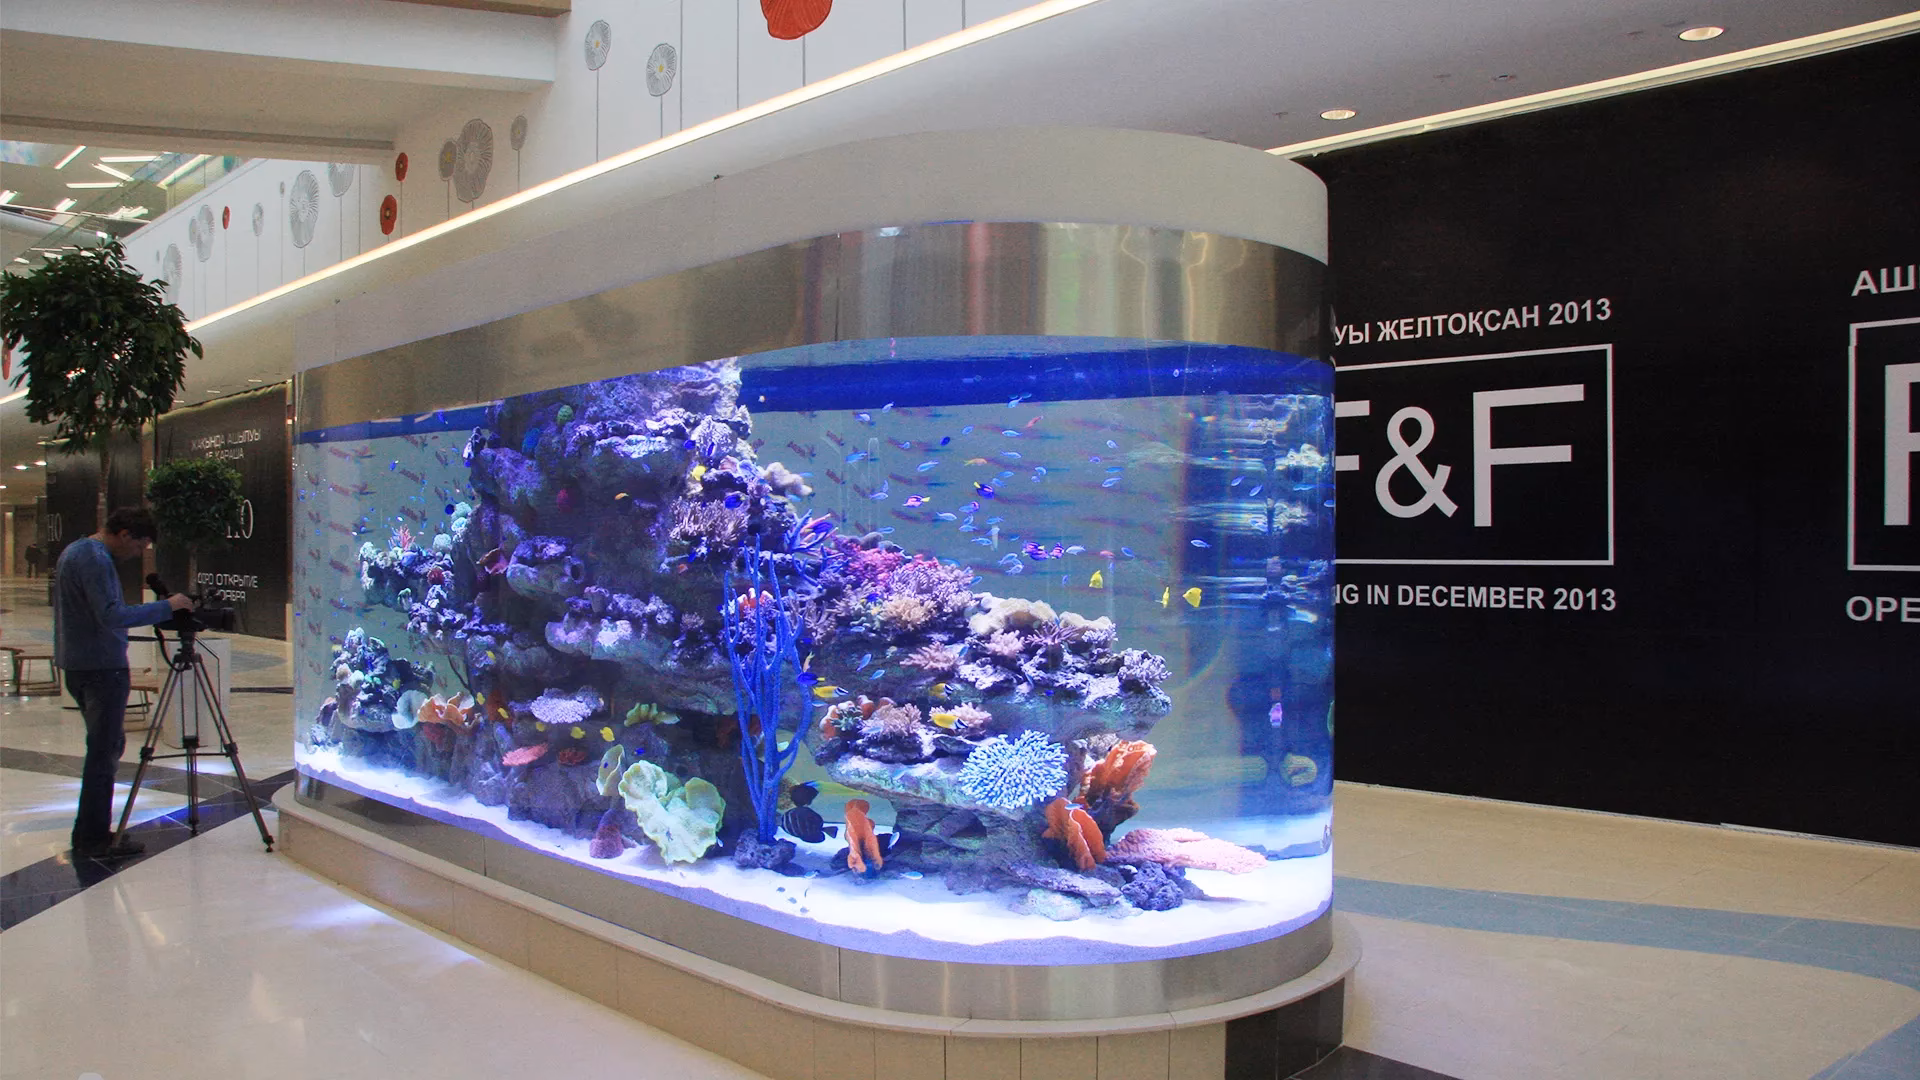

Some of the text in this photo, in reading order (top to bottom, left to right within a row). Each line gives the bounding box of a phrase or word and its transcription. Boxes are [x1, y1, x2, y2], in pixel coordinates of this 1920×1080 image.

[1851, 264, 1920, 297] АШ
[1376, 304, 1539, 342] ЖЕЛТОҚСАН
[1548, 298, 1611, 326] 2013
[1367, 584, 1389, 605] IN
[1397, 585, 1545, 610] DECEMBER
[1553, 588, 1616, 611] 2013
